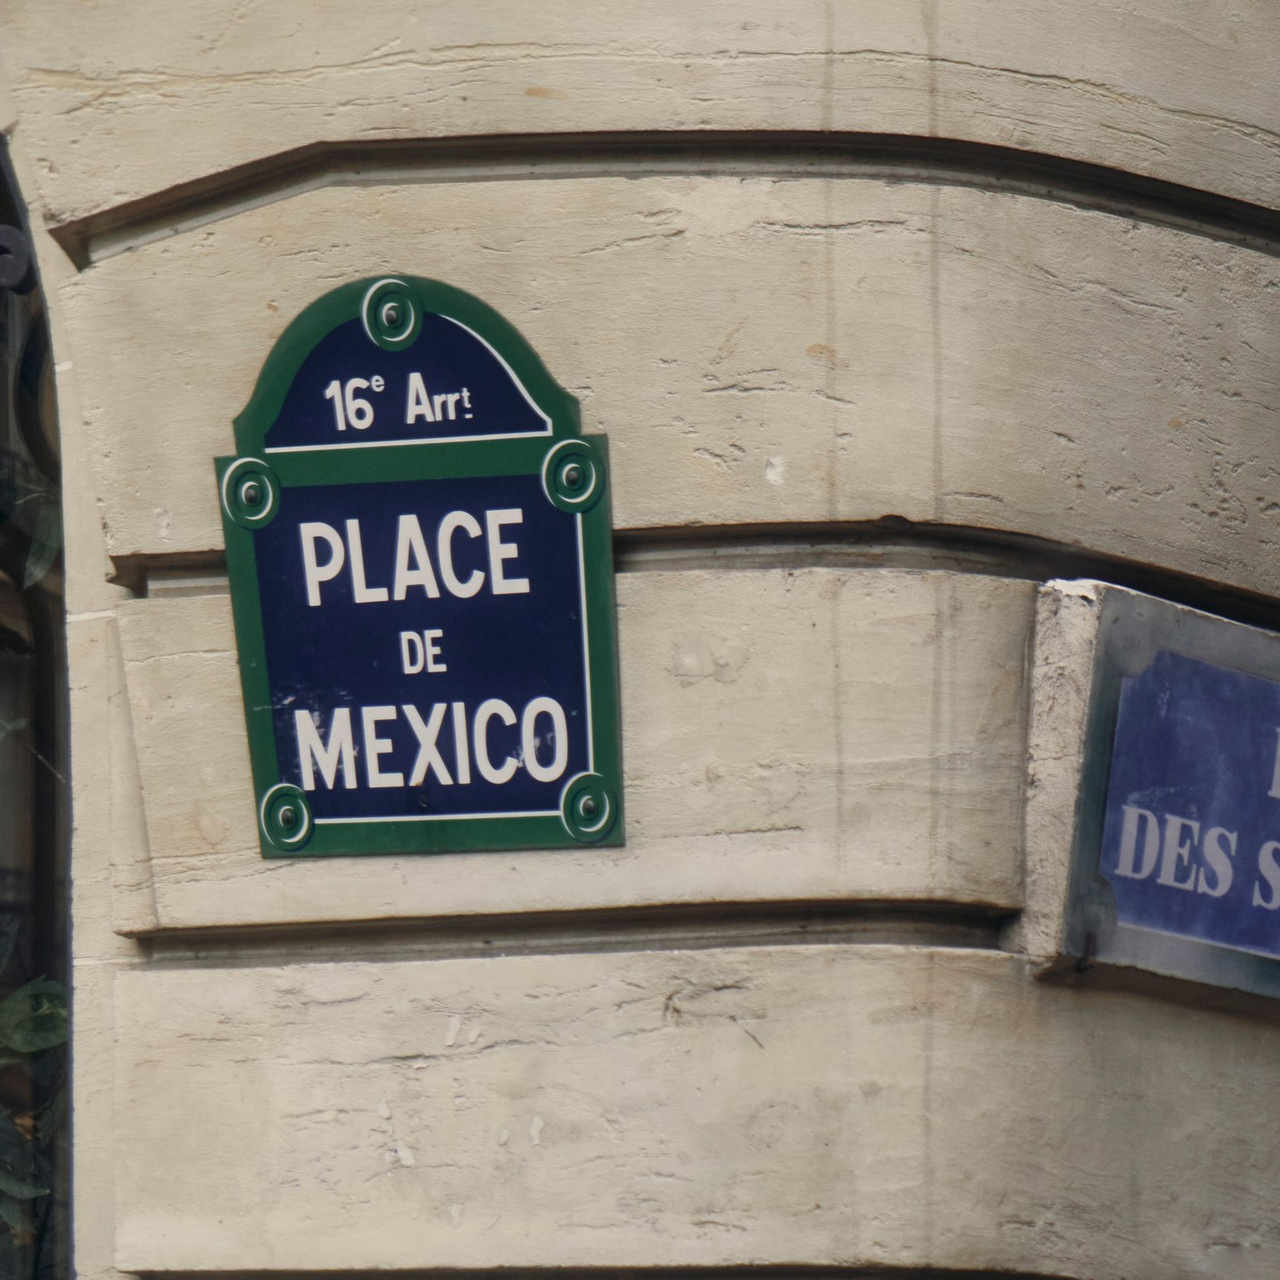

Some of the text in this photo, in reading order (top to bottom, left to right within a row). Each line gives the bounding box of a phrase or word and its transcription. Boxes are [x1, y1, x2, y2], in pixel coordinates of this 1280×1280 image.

[299, 508, 531, 607] PLACE
[399, 629, 448, 675] DE
[293, 696, 569, 791] MEXICO
[1114, 804, 1239, 898] DES
